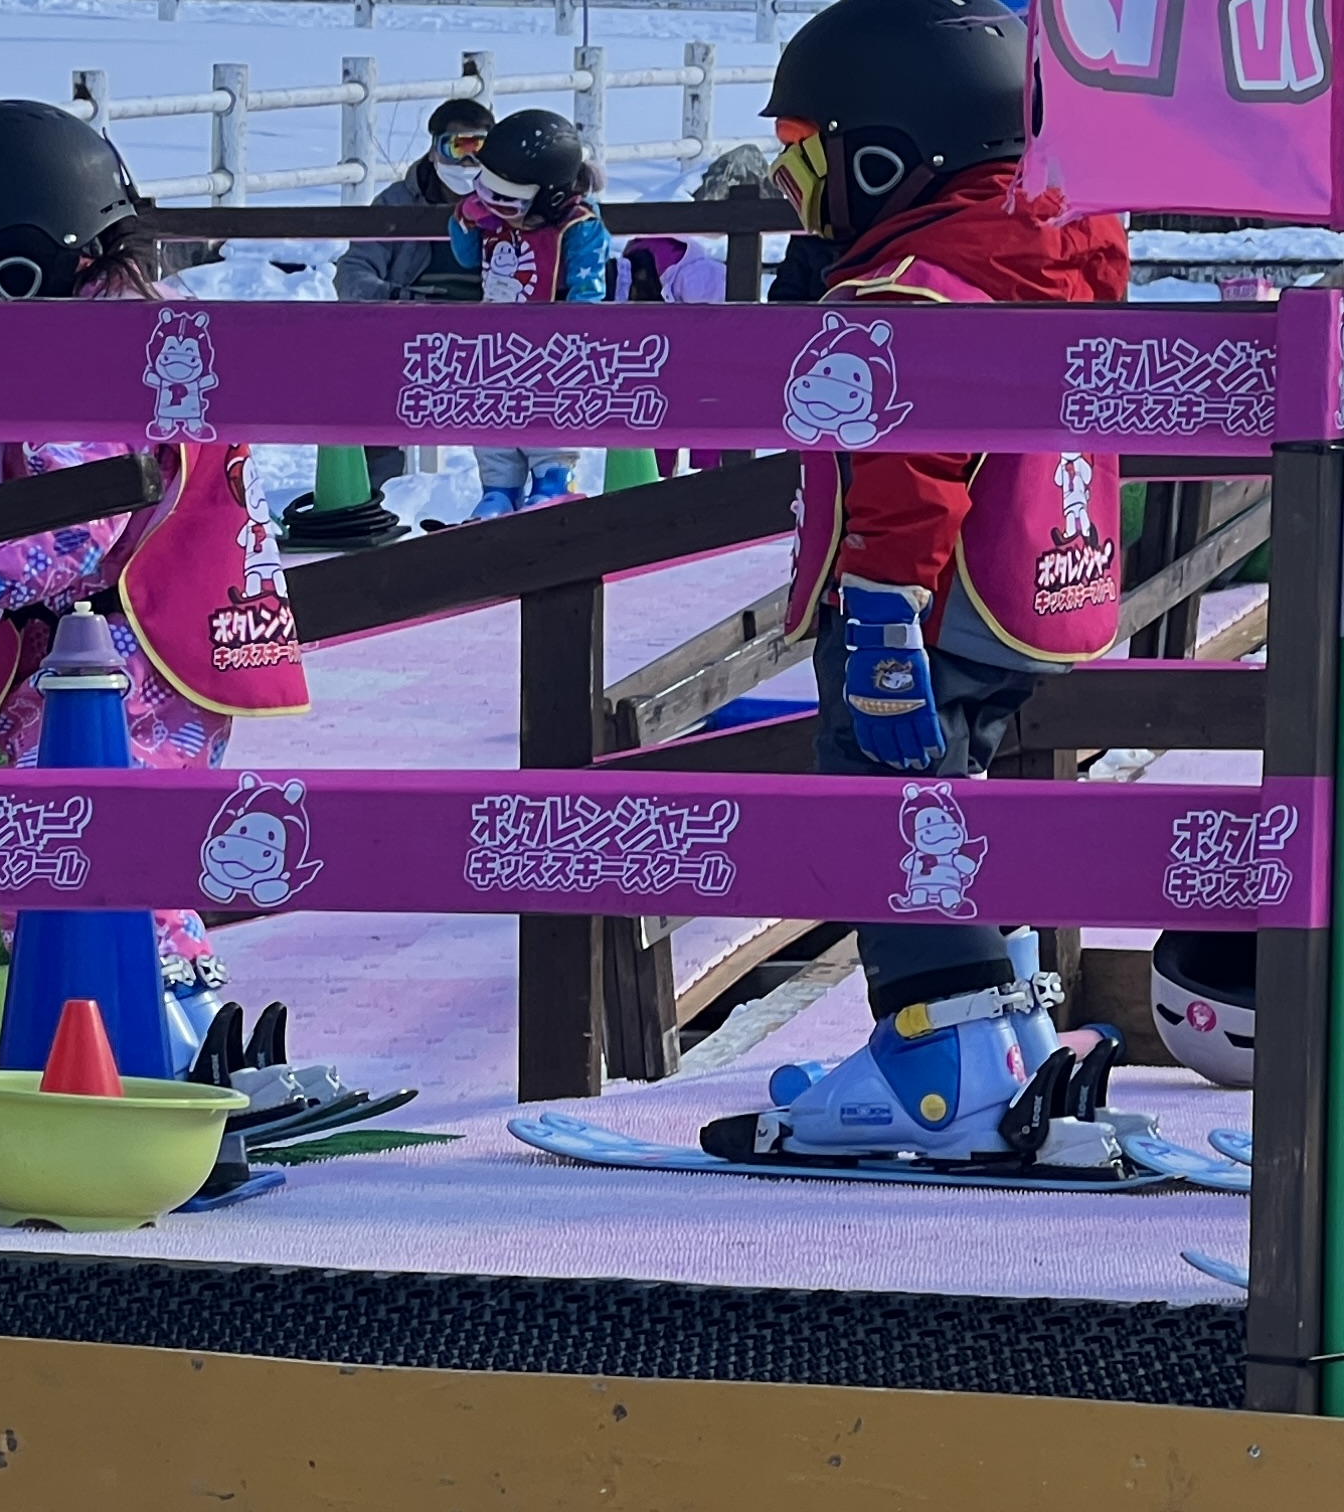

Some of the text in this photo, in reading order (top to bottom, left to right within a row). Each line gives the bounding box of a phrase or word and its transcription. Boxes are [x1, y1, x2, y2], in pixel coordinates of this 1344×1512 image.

[402, 332, 670, 385] ポタレンジャー
[397, 383, 669, 430] キッズスキースクール
[470, 795, 739, 851] ポタレンジャー
[464, 845, 736, 896] キッズスキースクール
